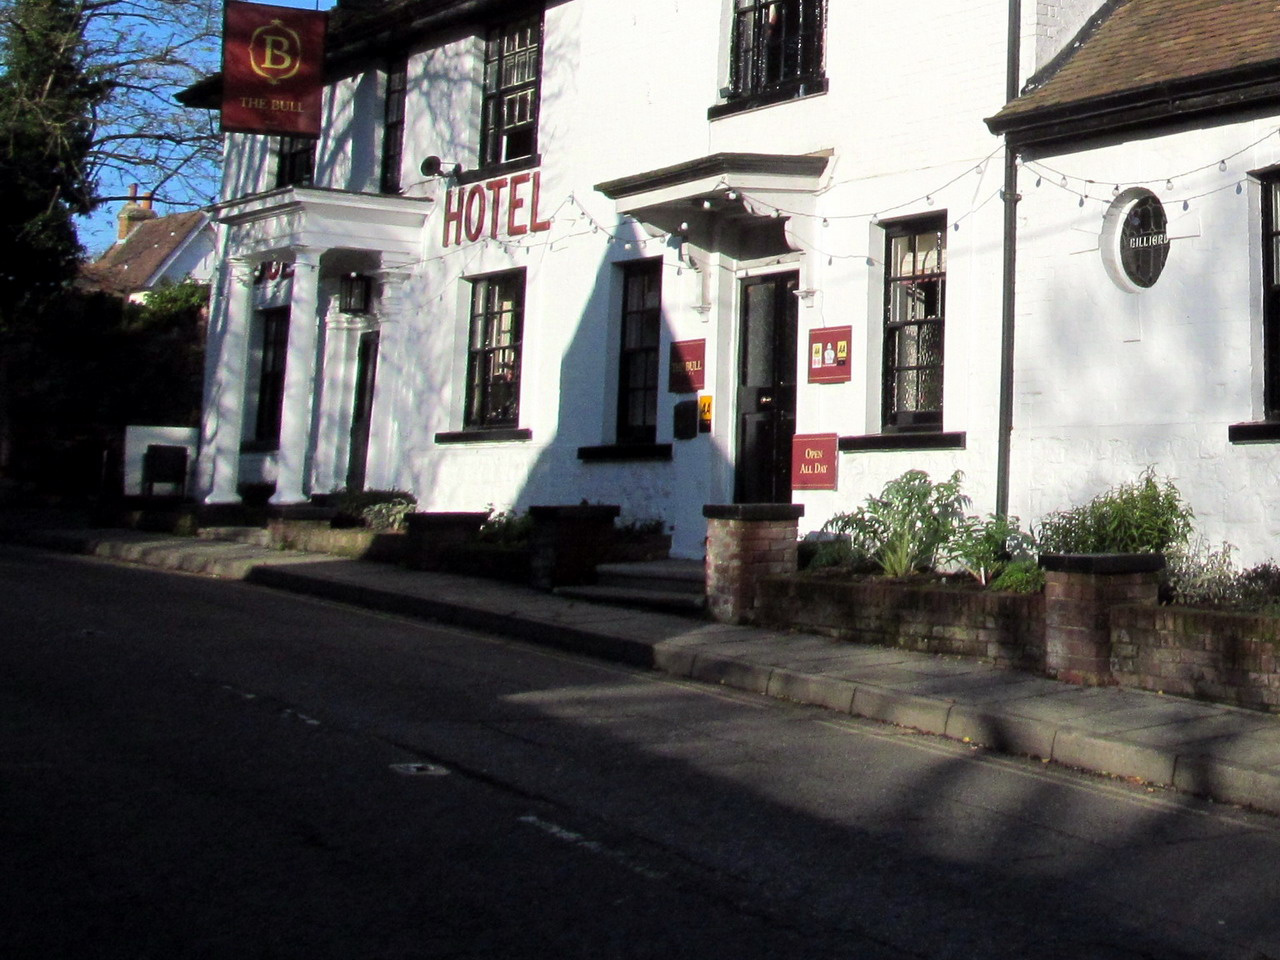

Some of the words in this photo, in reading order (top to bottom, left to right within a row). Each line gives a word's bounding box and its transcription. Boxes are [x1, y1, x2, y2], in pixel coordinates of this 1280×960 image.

[261, 35, 292, 69] B
[240, 97, 268, 109] THE
[271, 99, 305, 112] BULL
[442, 172, 550, 248] HOTEL
[1130, 234, 1169, 248] BILLIARD
[685, 360, 702, 371] BULL
